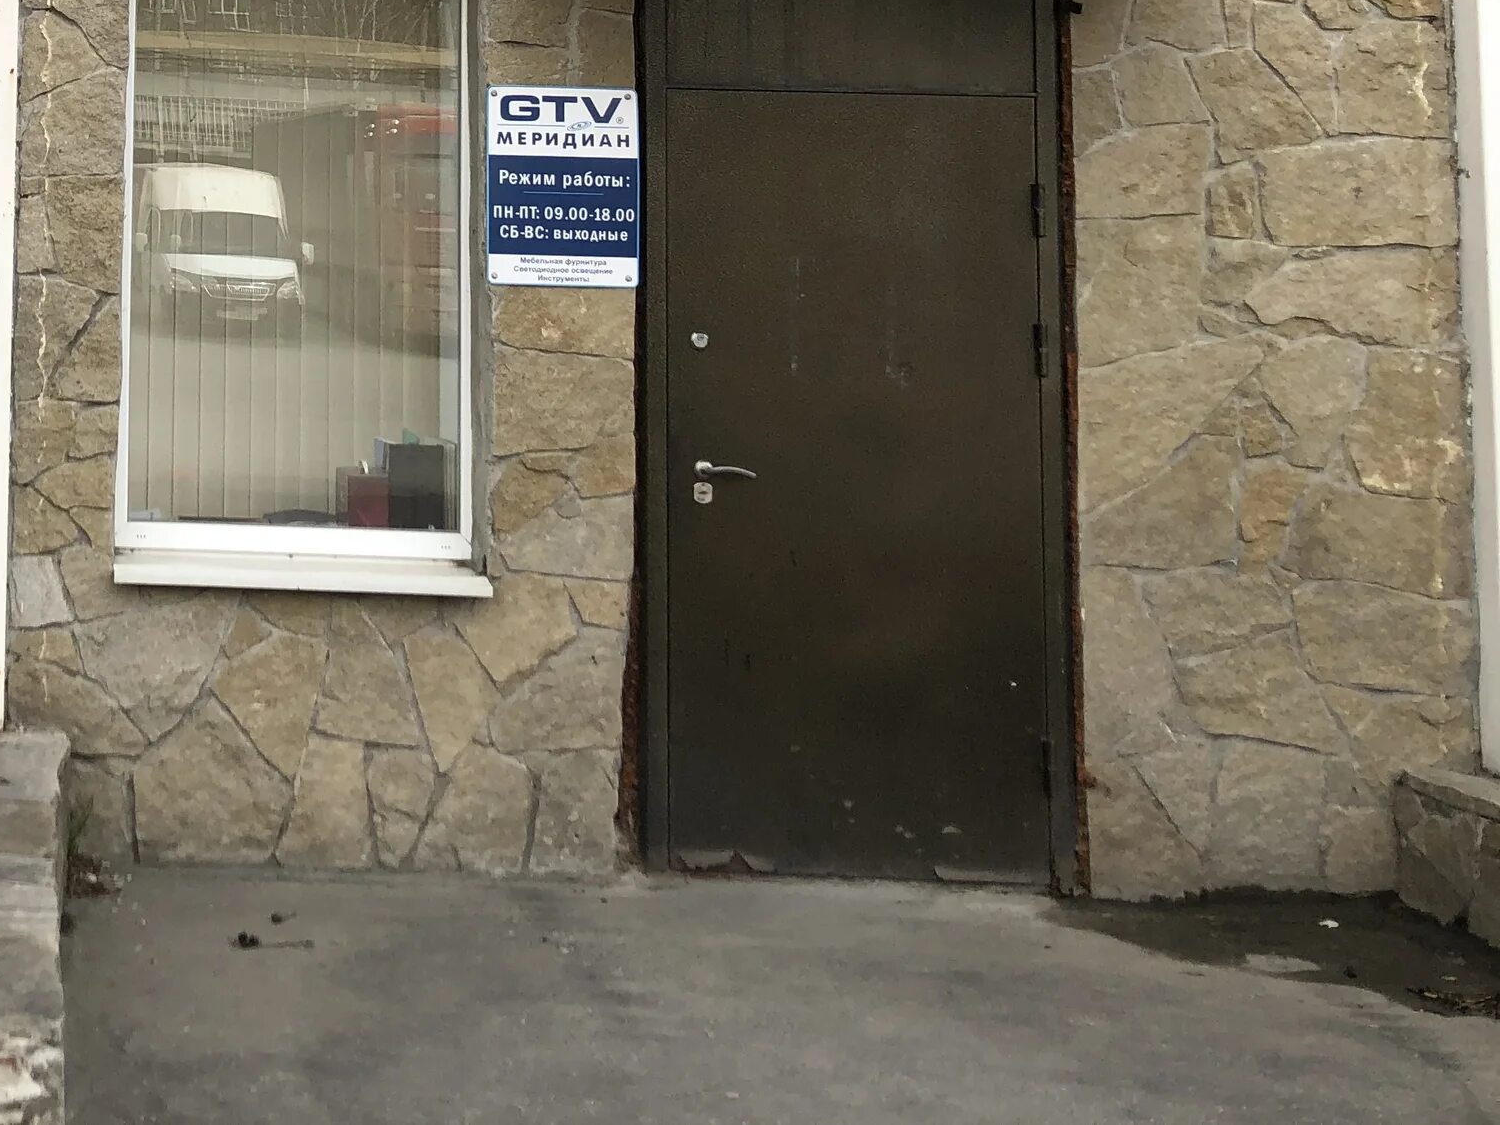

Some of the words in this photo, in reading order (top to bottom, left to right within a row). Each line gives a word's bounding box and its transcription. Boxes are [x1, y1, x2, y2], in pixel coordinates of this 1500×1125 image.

[499, 94, 623, 124] GTV
[496, 131, 631, 149] МЕРИДИАН
[499, 169, 556, 187] Режим
[562, 171, 631, 189] работы:
[493, 205, 541, 220] ПН-ПТ:
[544, 206, 636, 223] 09.00-18.00
[499, 225, 550, 240] СБ-ВС:
[553, 229, 629, 242] выходные
[513, 265, 570, 274] Светодиодное
[571, 267, 614, 275] освещение
[520, 257, 563, 265] Мебельная
[564, 258, 607, 267] фурнитура
[537, 274, 591, 283] Инструменты
